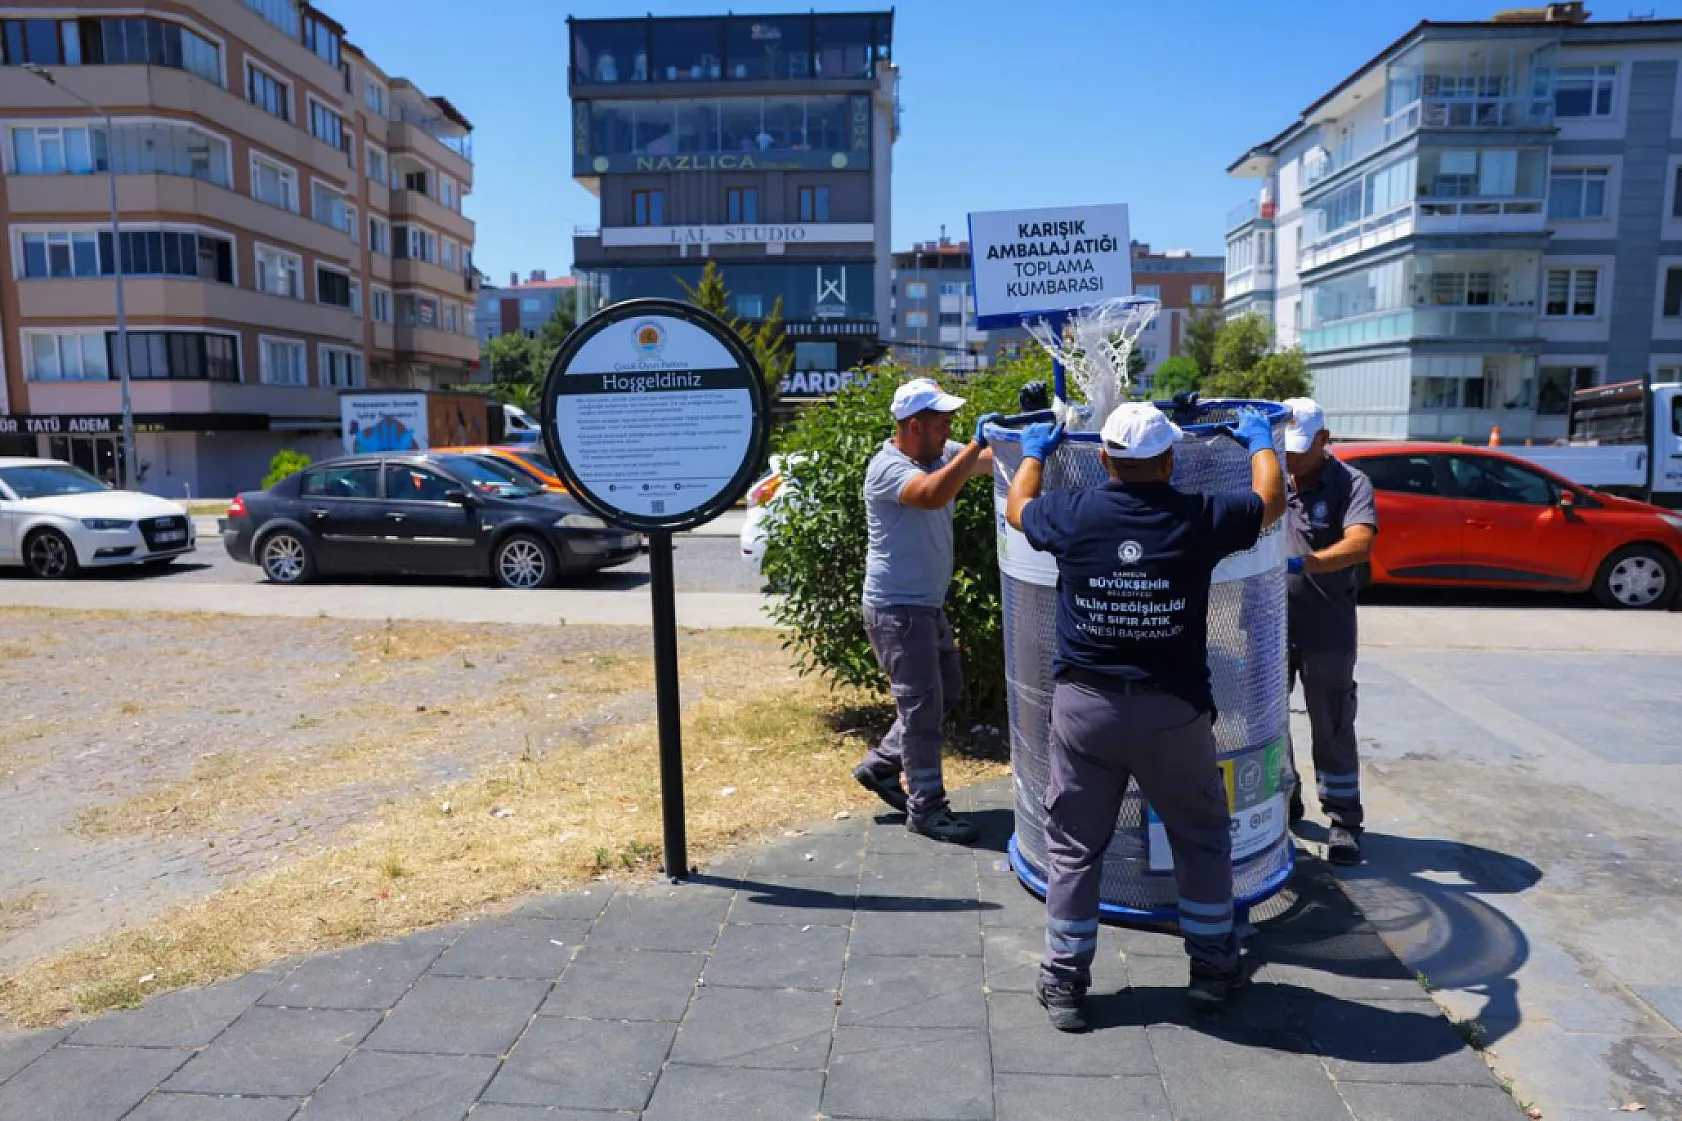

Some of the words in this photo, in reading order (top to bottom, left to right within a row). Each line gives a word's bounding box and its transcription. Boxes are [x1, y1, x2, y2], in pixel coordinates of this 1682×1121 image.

[636, 154, 756, 170] NAZLICA
[670, 227, 712, 243] LAL
[724, 226, 807, 242] STUDIO
[1018, 220, 1085, 240] KARIŞIK
[987, 241, 1070, 260] AMBALAJ
[1073, 234, 1117, 254] ATIĞI
[1013, 258, 1094, 277] TOPLAMA
[1006, 276, 1104, 297] KUMBARASI
[26, 416, 60, 432] TATÜ
[69, 417, 110, 432] ADEM
[1089, 577, 1170, 590] BÜYÜKŞEHİR
[1088, 612, 1104, 623] VE
[1107, 615, 1139, 626] SIFIR
[1141, 615, 1171, 627] ATIK
